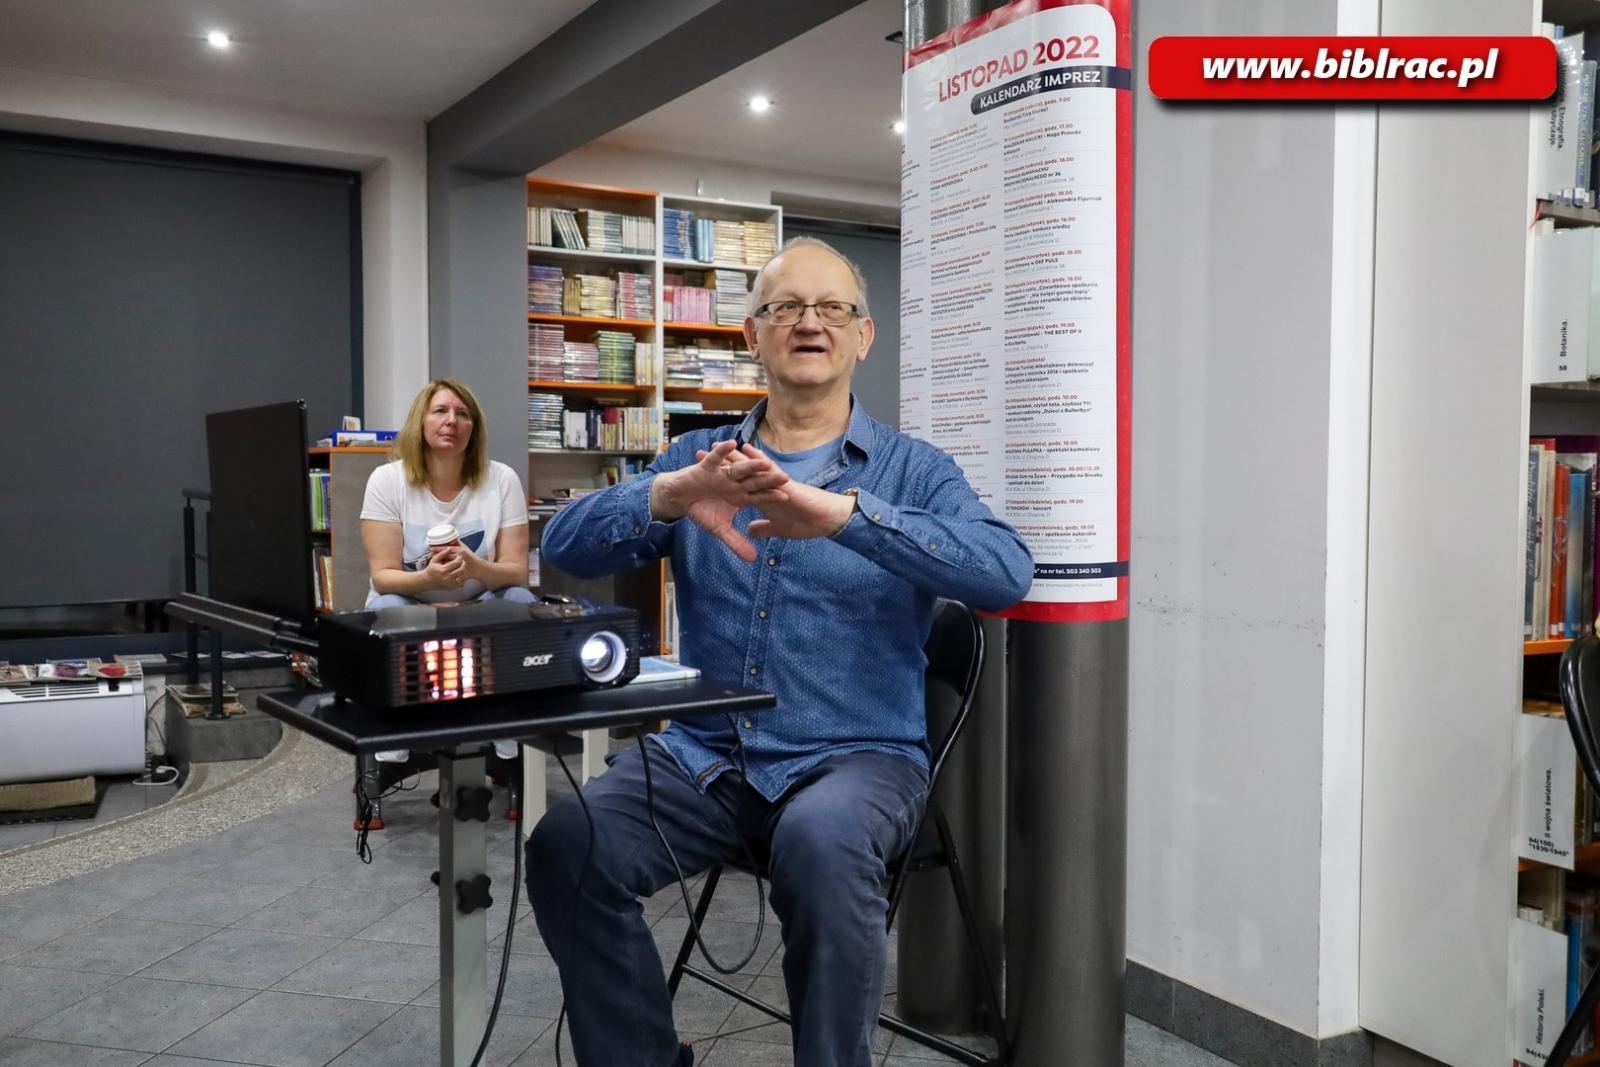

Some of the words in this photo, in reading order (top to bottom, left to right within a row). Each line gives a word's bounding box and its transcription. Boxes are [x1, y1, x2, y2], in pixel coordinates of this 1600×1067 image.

[938, 49, 1028, 102] LISTOPAD
[1032, 35, 1100, 65] 2022
[979, 78, 1042, 109] KALENDARZ
[1044, 70, 1101, 87] IMPREZ
[1559, 318, 1568, 357] Botanika.
[522, 653, 554, 667] acer
[1544, 808, 1552, 832] wojna
[1536, 1011, 1545, 1045] Historia
